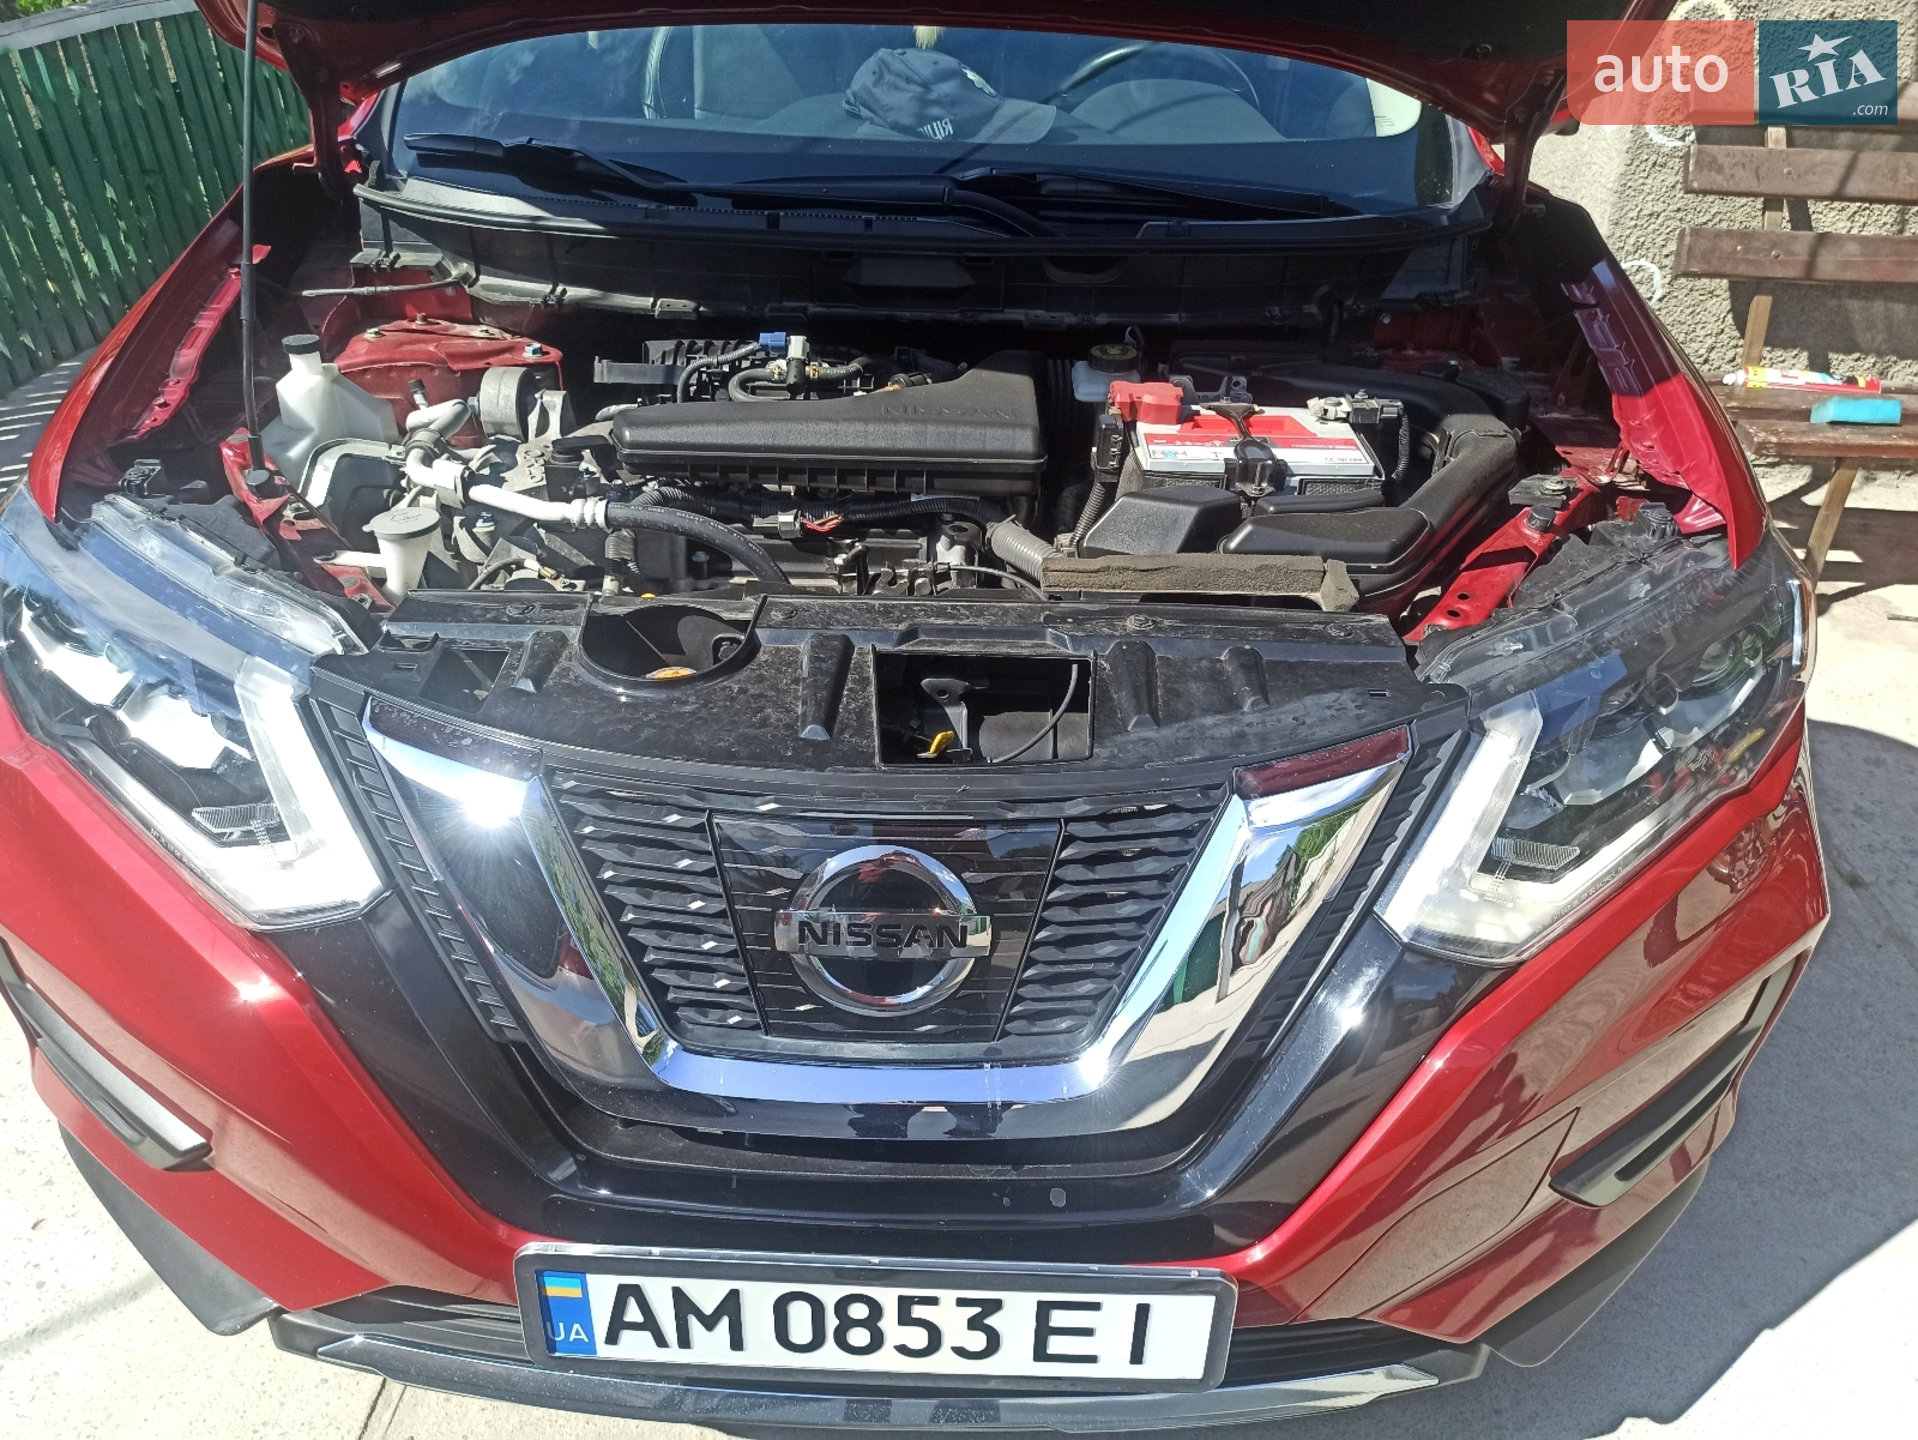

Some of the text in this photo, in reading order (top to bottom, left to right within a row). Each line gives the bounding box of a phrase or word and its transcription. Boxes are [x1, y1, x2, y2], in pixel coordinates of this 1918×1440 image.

[881, 405, 1017, 420] NISSAN
[798, 921, 968, 948] NISSAN
[546, 1322, 590, 1343] UA
[604, 1283, 1151, 1365] AM 0853 EI
